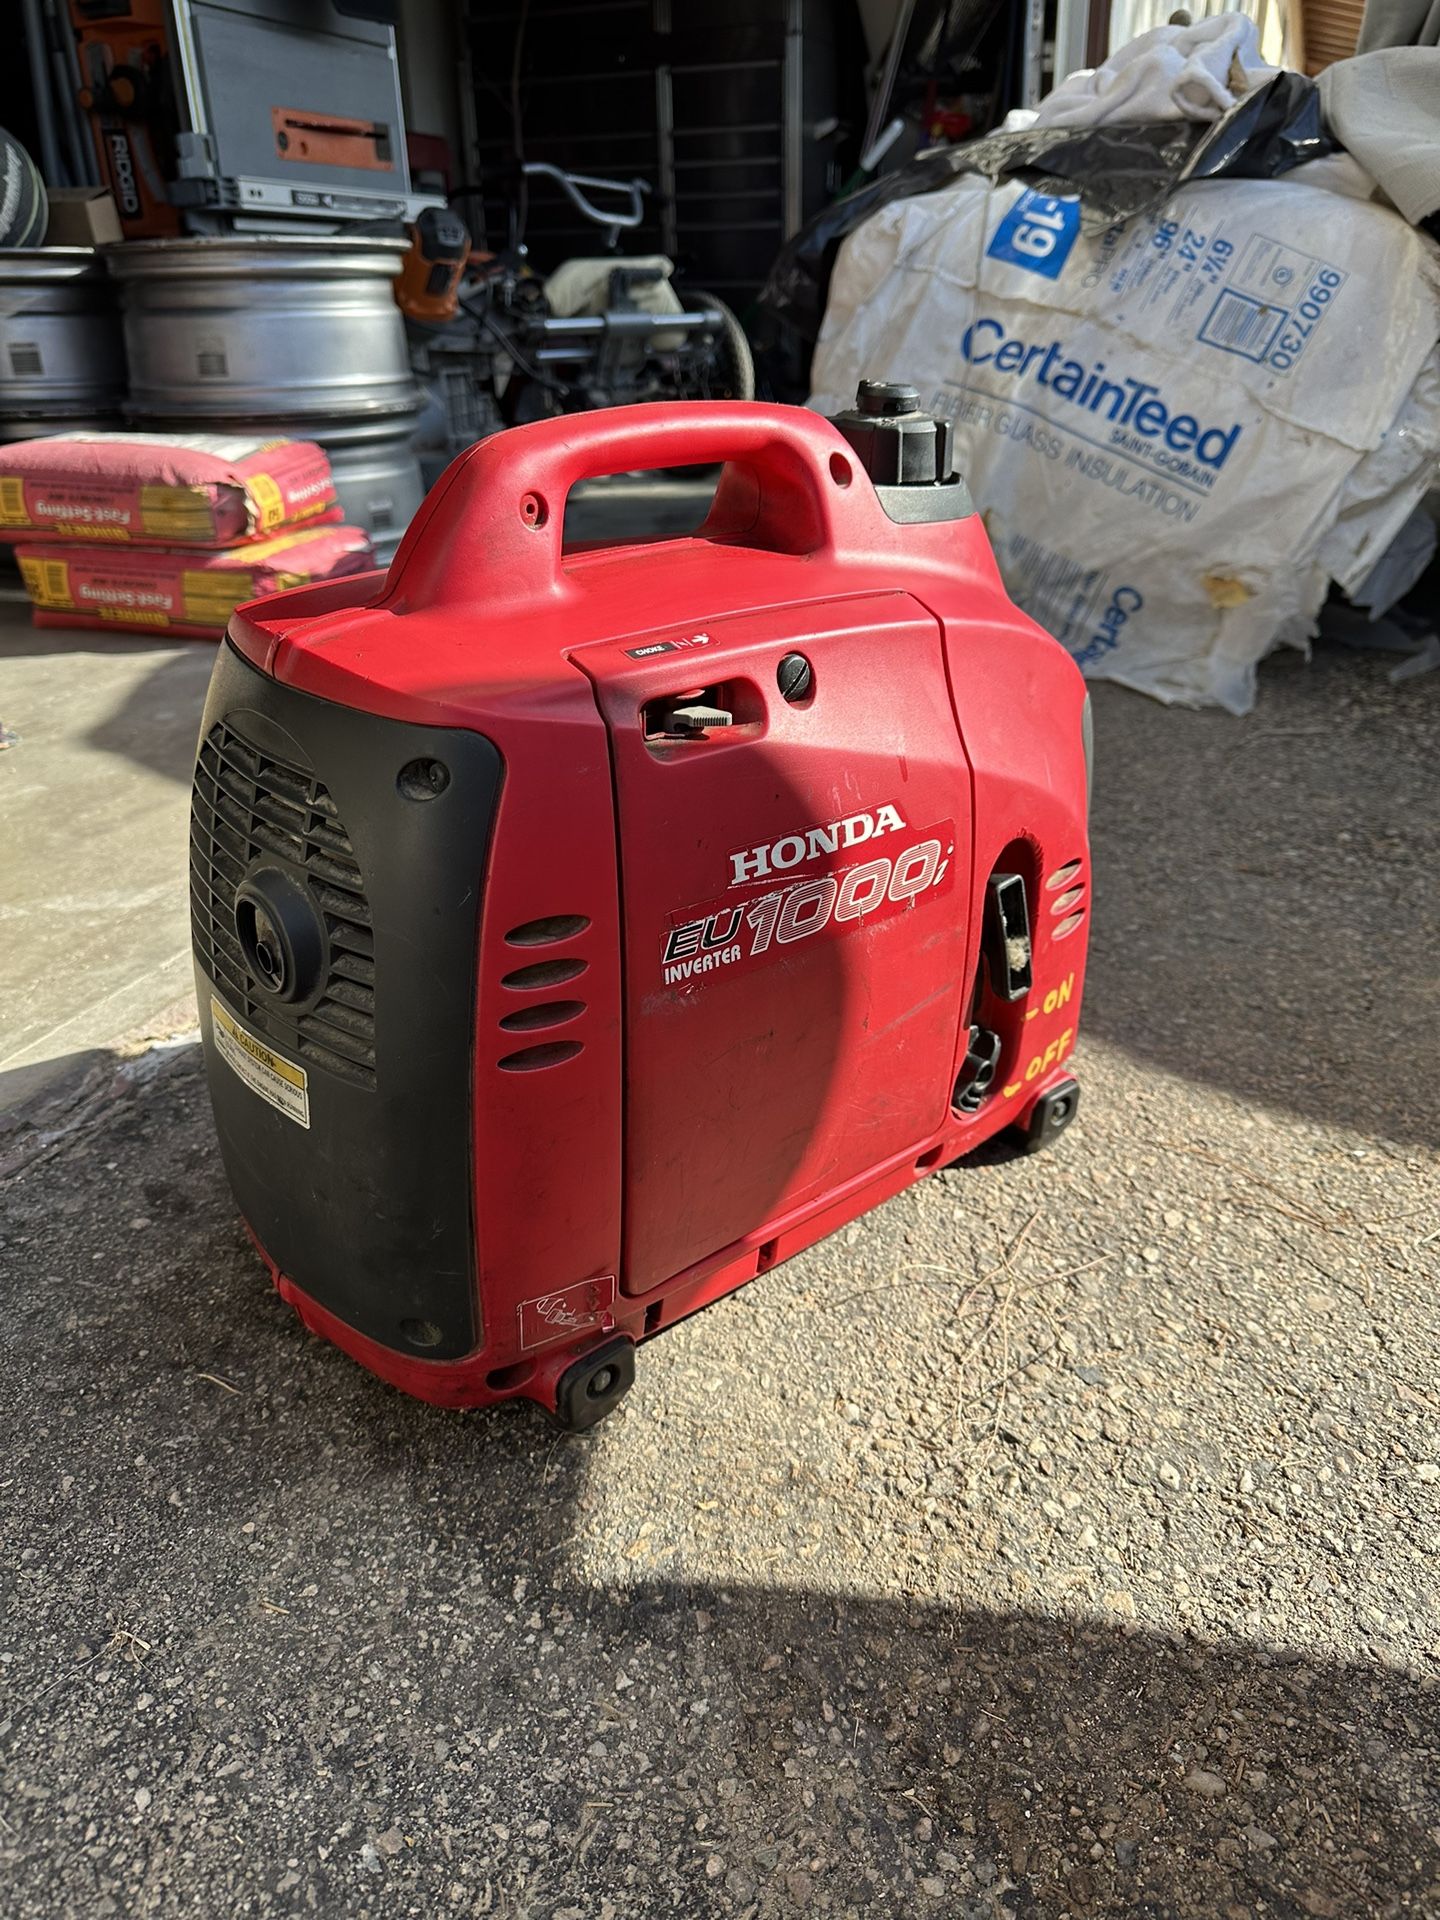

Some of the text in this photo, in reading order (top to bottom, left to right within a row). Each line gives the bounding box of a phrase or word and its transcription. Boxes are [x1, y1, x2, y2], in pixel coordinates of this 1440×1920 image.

[112, 134, 139, 213] RIDGID
[1177, 229, 1206, 273] 24"
[1269, 268, 1342, 371] 990730
[960, 318, 1243, 470] CertainTeed
[995, 414, 1065, 461] GLASS
[1065, 447, 1201, 523] INSULATION
[1109, 428, 1217, 488] SAINT-GOBAIN
[635, 645, 665, 656] CHOKE
[729, 803, 907, 885] HONDA
[662, 838, 955, 964] EU1000i
[664, 944, 742, 985] INVERTER
[1043, 972, 1075, 1015] ON
[240, 1036, 276, 1068] CAUTION
[1025, 1027, 1073, 1081] OFF
